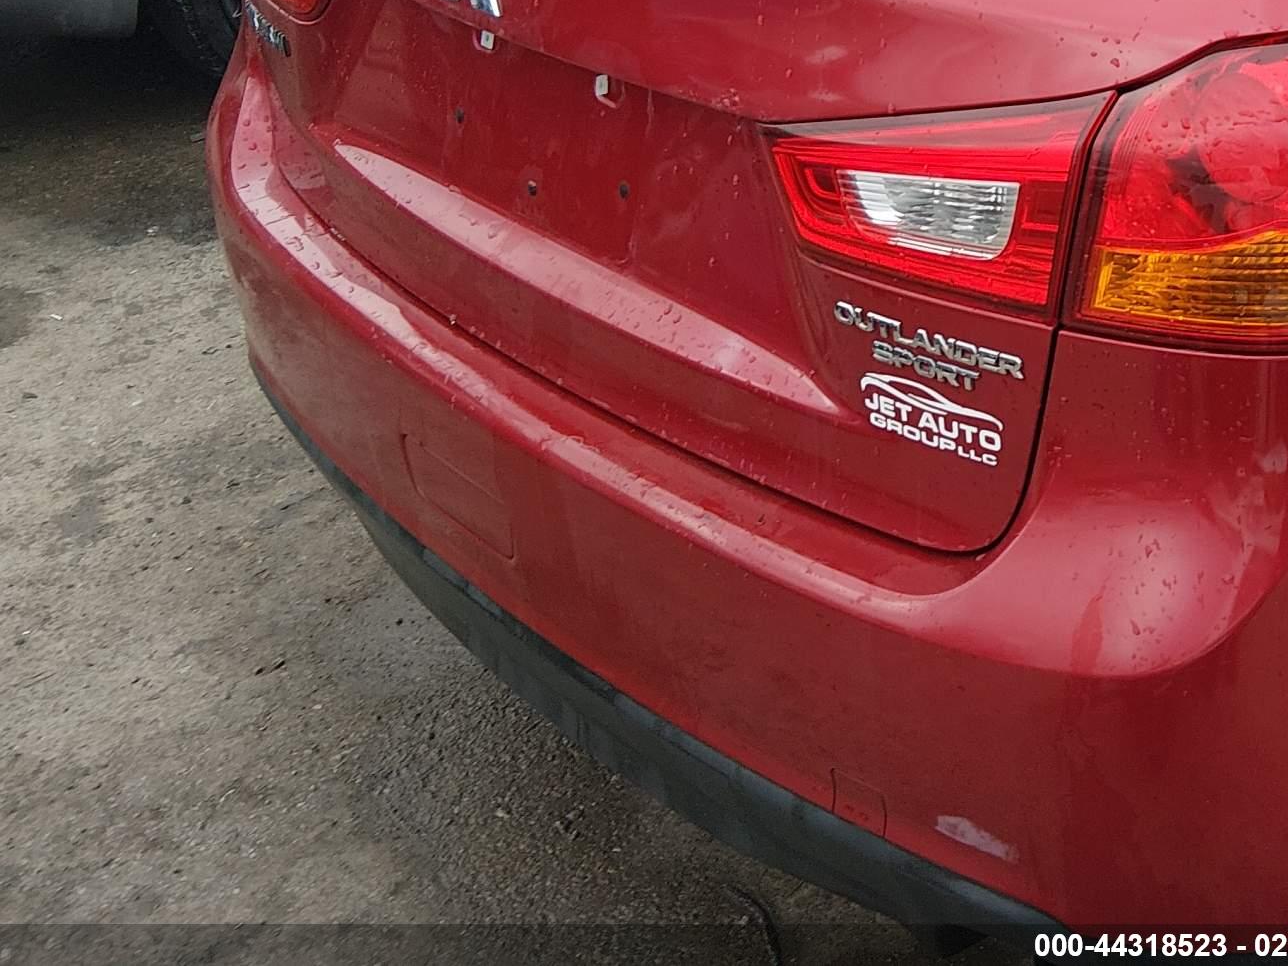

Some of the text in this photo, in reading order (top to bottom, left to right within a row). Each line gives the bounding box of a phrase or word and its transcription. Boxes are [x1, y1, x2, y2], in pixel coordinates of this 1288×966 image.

[834, 301, 1025, 379] OUTLANDER
[873, 341, 979, 390] SPORT
[864, 393, 1001, 452] JET AUTO
[870, 414, 998, 466] GROUP LLC
